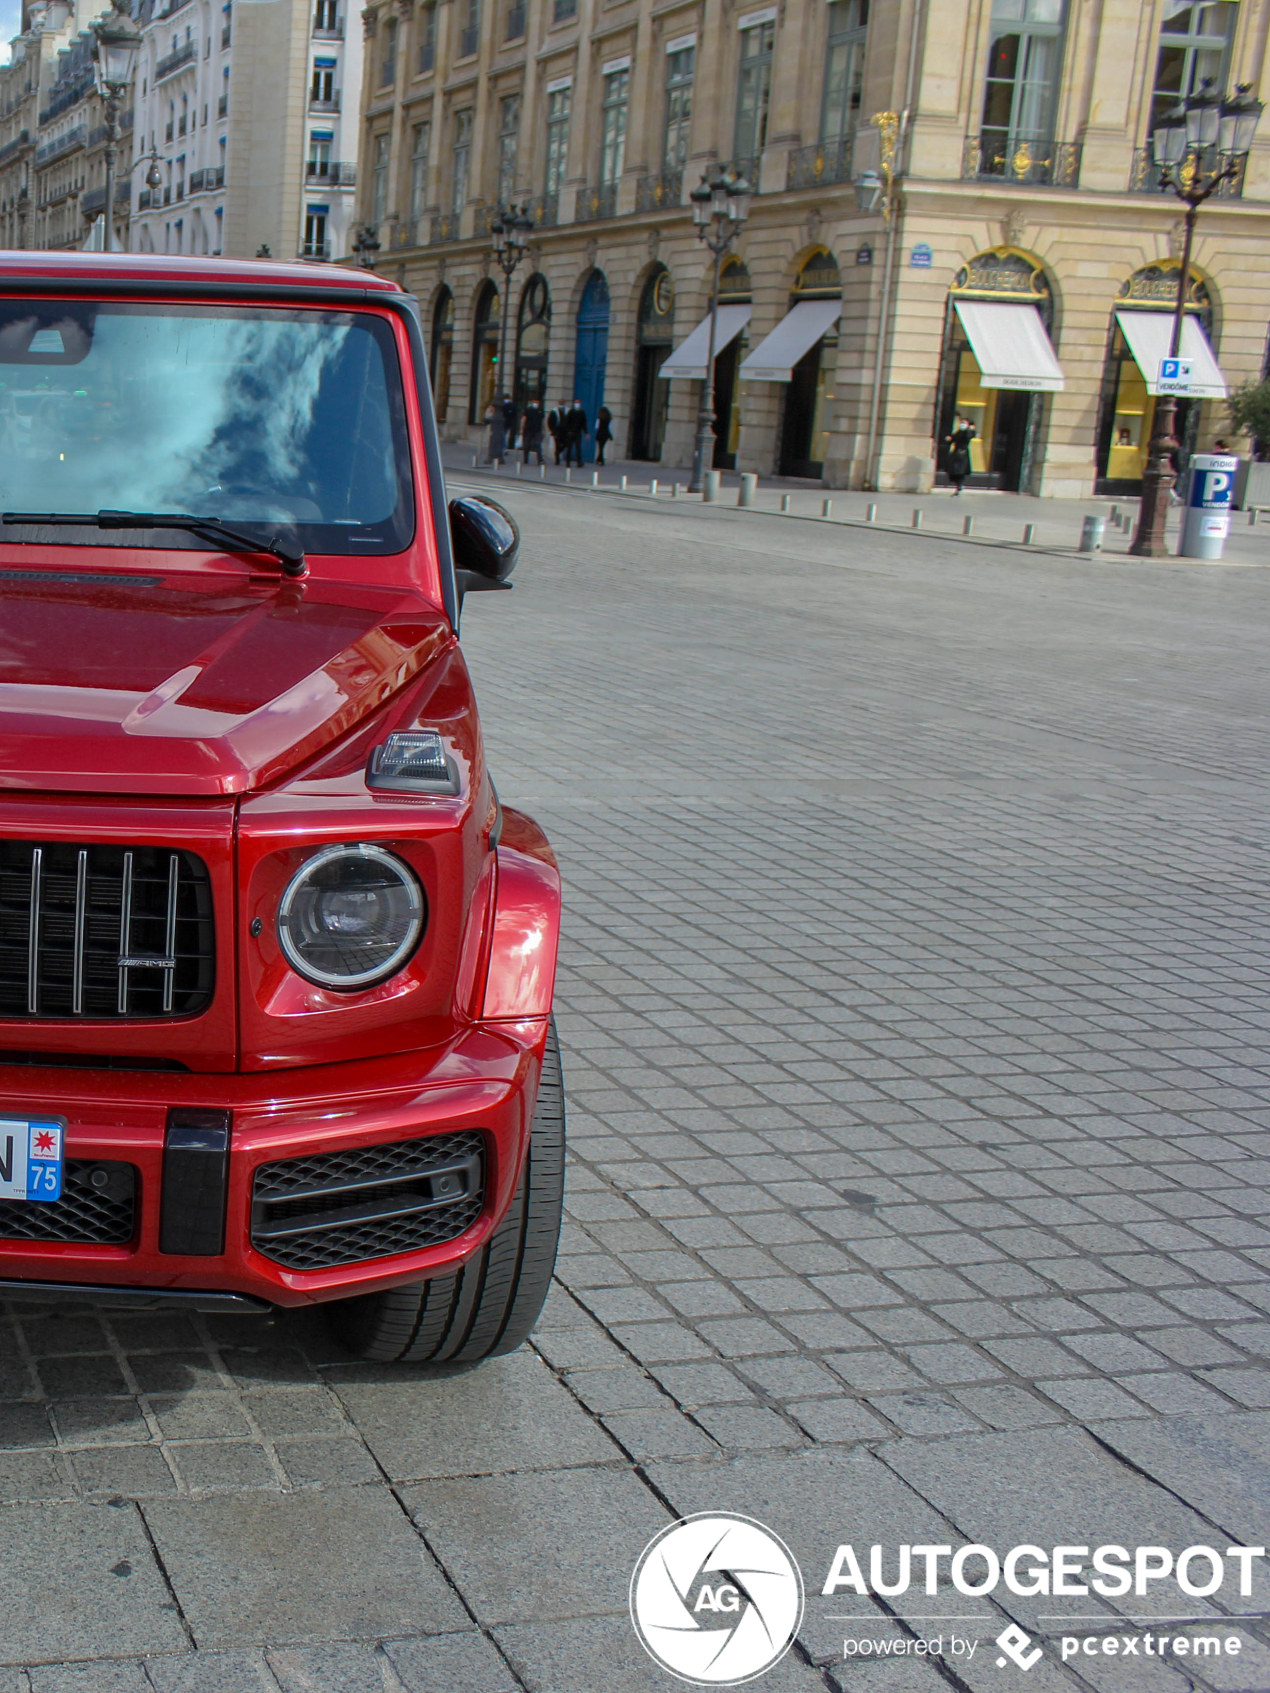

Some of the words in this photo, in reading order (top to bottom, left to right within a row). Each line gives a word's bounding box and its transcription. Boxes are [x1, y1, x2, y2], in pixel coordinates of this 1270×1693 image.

[1164, 362, 1176, 376] P
[1159, 382, 1190, 391] VENDÔME
[1202, 471, 1229, 500] P
[31, 1165, 57, 1191] 75
